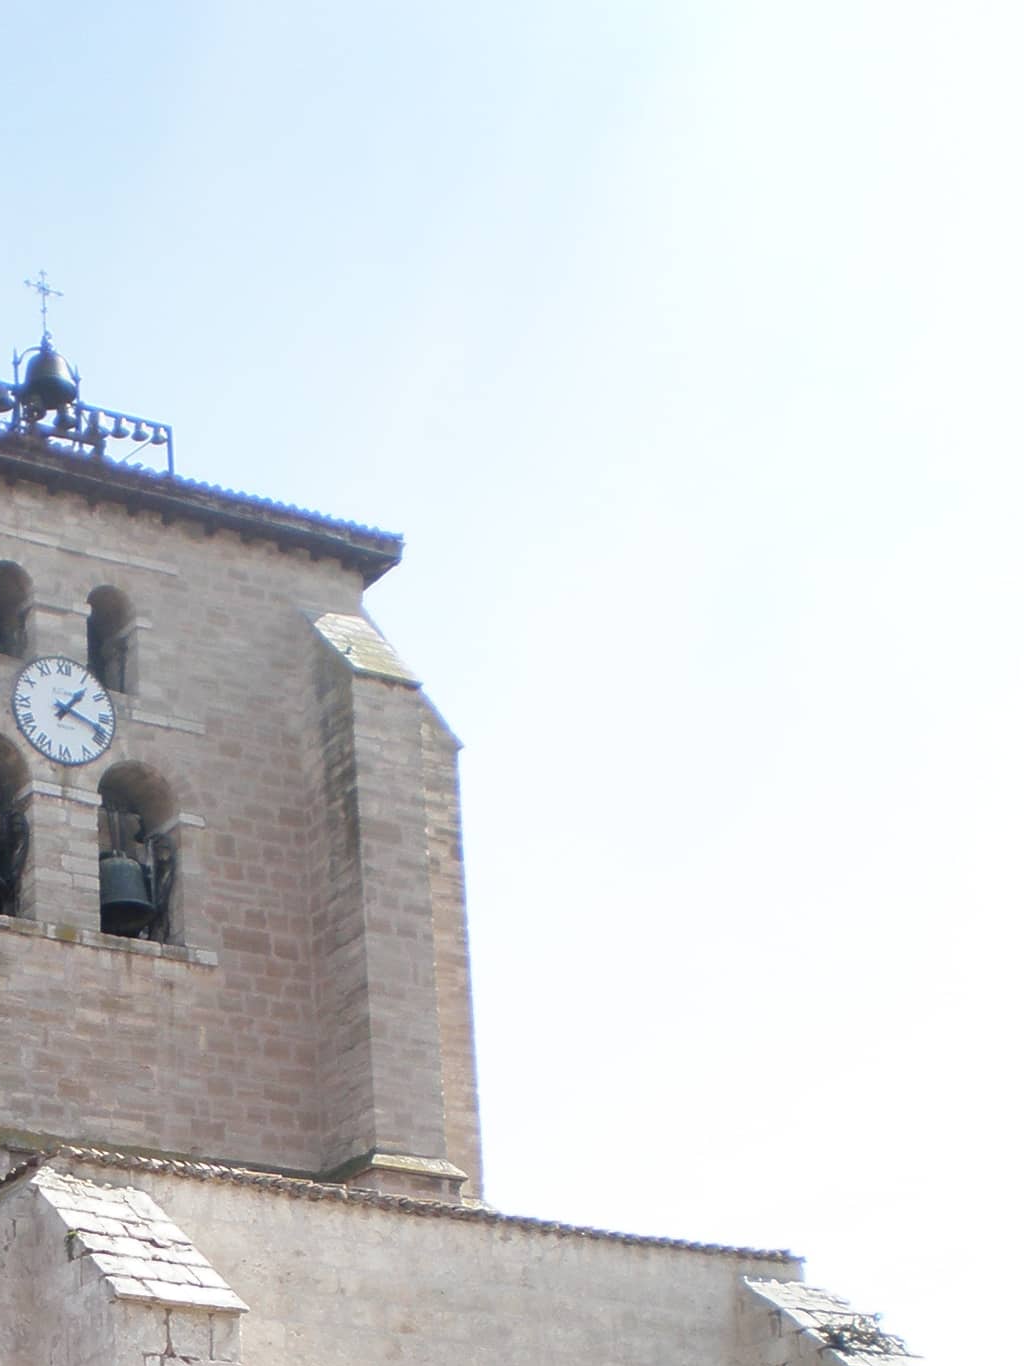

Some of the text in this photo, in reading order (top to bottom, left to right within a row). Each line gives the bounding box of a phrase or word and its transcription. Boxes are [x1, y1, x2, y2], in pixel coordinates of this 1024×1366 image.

[37, 663, 51, 677] XI
[56, 663, 72, 677] XII
[23, 675, 37, 688] X
[16, 694, 31, 708] IX
[92, 692, 105, 702] II
[98, 712, 110, 725] III
[36, 732, 52, 751] VII
[59, 744, 72, 759] VI
[81, 744, 95, 759] V
